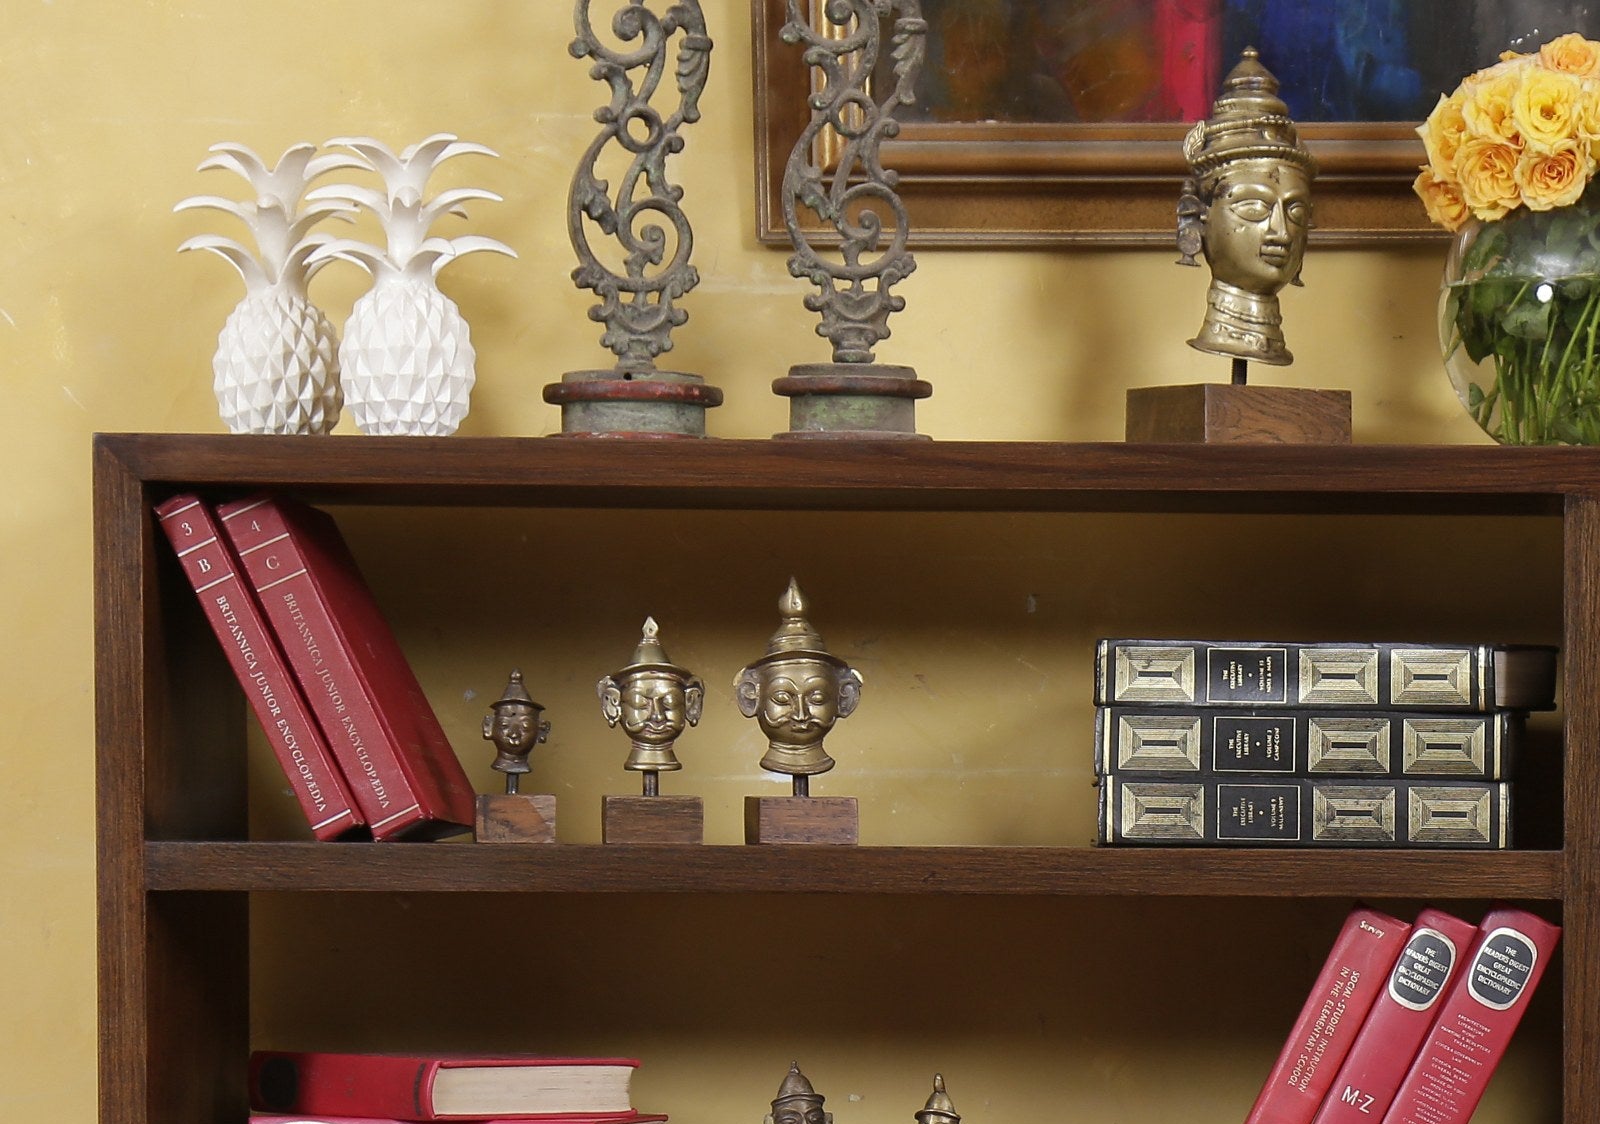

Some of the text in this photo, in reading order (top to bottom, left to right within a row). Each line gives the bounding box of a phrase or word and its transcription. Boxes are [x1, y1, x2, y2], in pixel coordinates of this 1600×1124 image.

[181, 521, 193, 536] 3
[251, 520, 262, 532] 4
[198, 558, 212, 573] B
[265, 556, 281, 570] C
[215, 595, 258, 670] BRITANNICA
[250, 671, 281, 717] JUNIOR
[282, 593, 324, 667] BRITANNICA
[315, 669, 346, 713] JUNIOR
[1359, 920, 1385, 939] Survey
[1425, 947, 1436, 958] THE
[1505, 946, 1517, 957] THE
[1413, 962, 1432, 975] GREAT
[1427, 959, 1448, 973] DIGEST
[1493, 961, 1513, 975] GREAT
[1508, 959, 1530, 973] DIGEST
[1398, 976, 1431, 996] DICTIONARY
[1477, 975, 1512, 996] DICTIONARY
[1287, 966, 1351, 1087] IN THE ELEMENTARY SCHOOL
[1324, 1002, 1346, 1037] STUDIES
[1299, 1038, 1329, 1093] INSTRUCTION
[1341, 1085, 1375, 1114] M-Z
